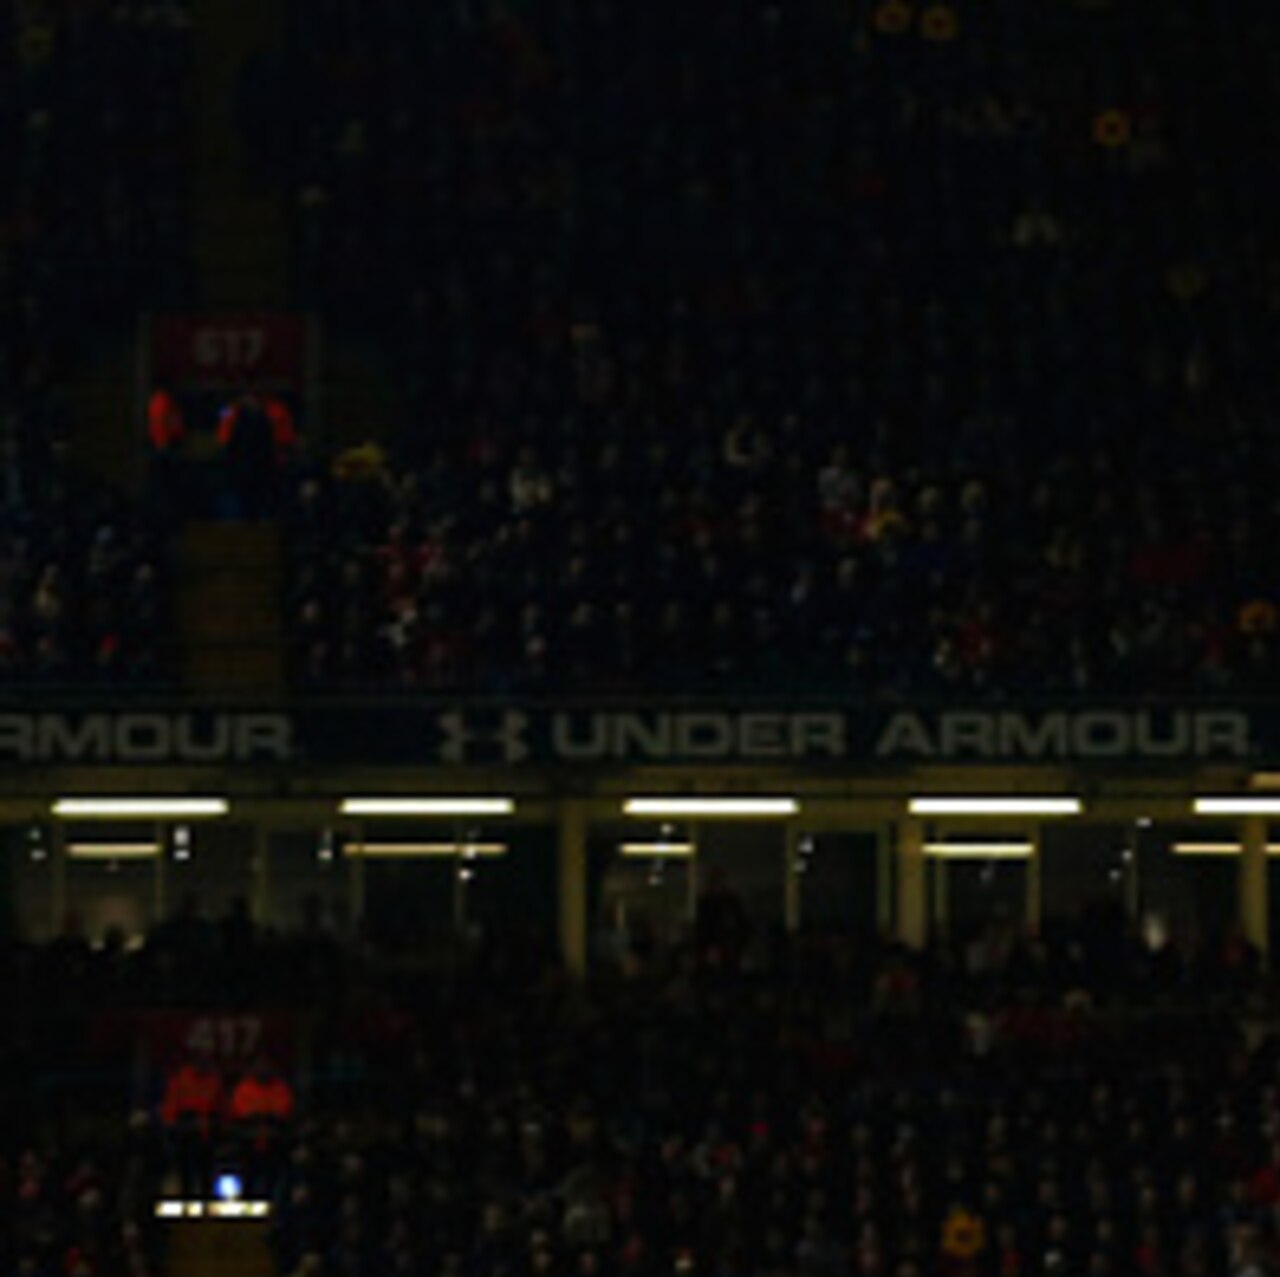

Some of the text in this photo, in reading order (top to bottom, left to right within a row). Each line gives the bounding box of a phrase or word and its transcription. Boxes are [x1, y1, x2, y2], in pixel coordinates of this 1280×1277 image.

[551, 710, 1251, 758] UNDER ARMOUR
[184, 1014, 263, 1056] 417
